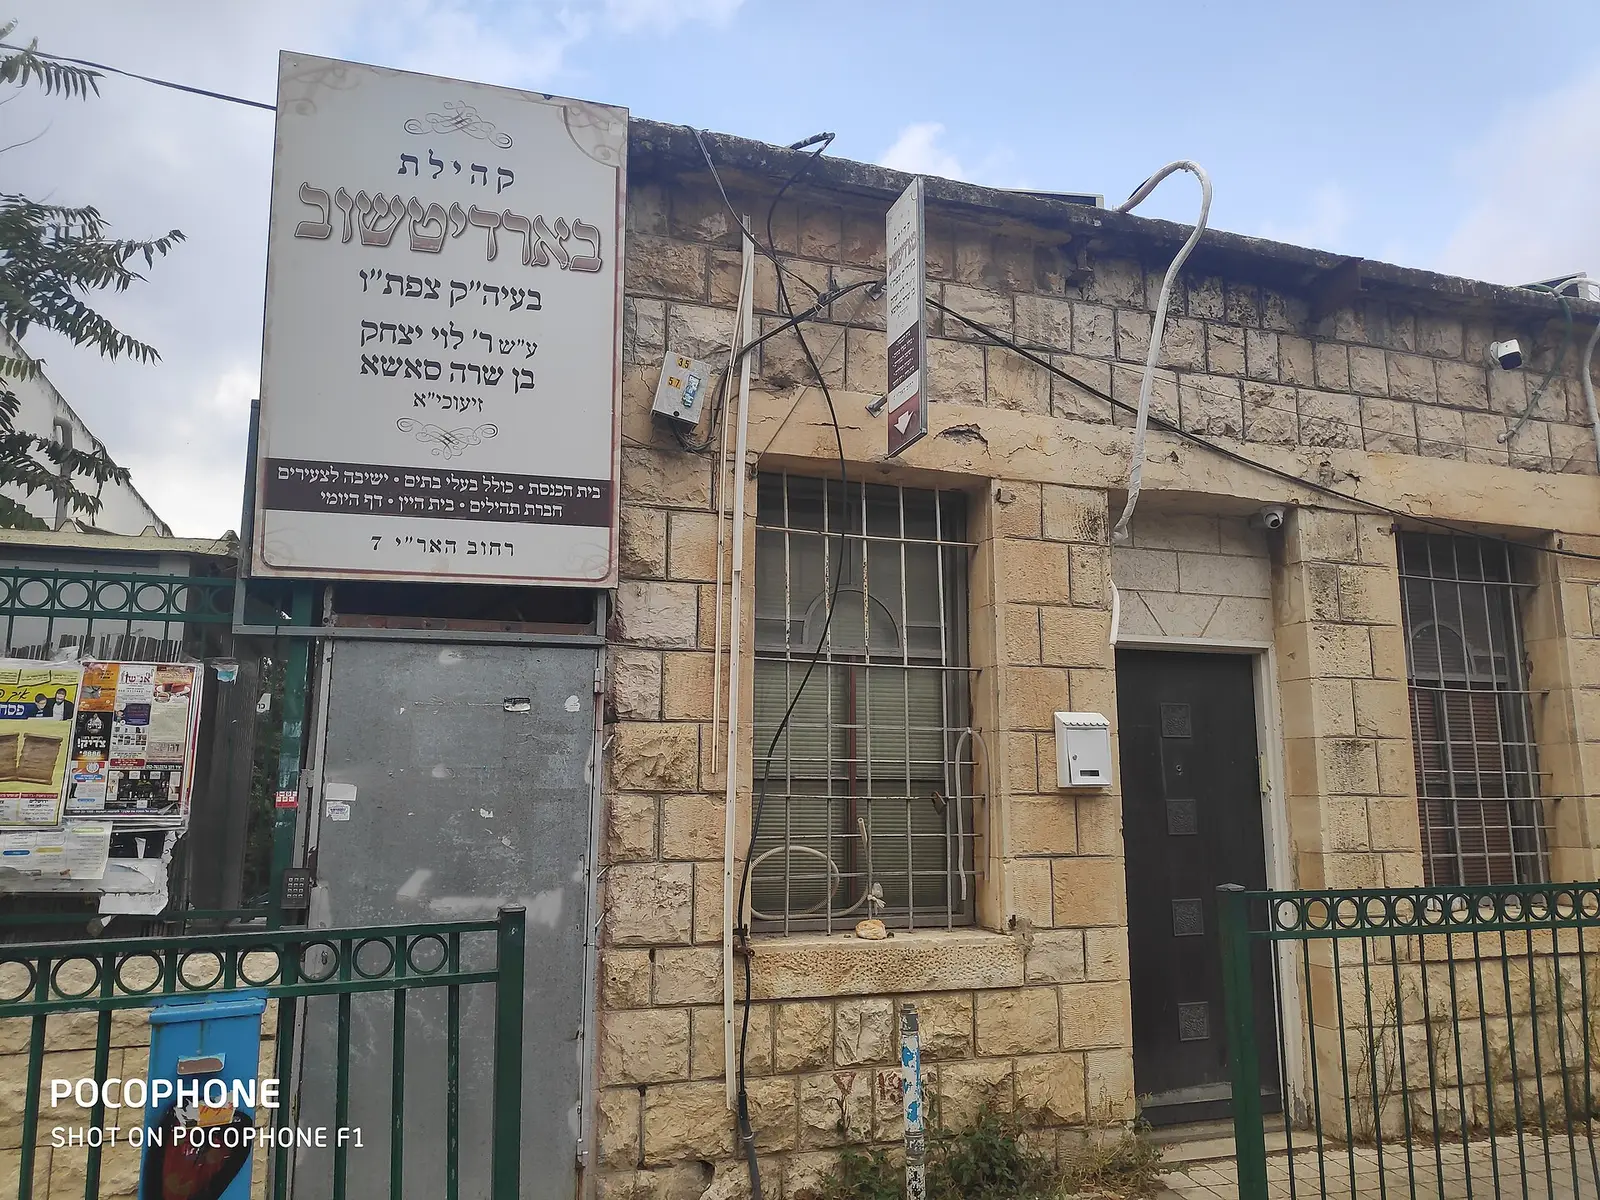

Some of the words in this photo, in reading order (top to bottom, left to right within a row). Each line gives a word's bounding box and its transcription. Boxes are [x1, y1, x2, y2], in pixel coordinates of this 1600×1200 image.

[397, 149, 515, 194] קהילת
[294, 181, 603, 274] בארדיטשוב
[450, 280, 542, 311] בעיה"ק
[361, 319, 423, 347] יצחק
[432, 321, 464, 350] לוי
[360, 354, 441, 380] סאשא
[677, 358, 690, 369] 35
[450, 361, 504, 385] שרה
[512, 367, 535, 394] בן
[278, 465, 339, 483] לצעירים
[344, 471, 388, 485] ישיבה
[405, 475, 441, 488] בתים
[446, 471, 480, 492] בעלי
[483, 475, 513, 493] כולל
[528, 483, 572, 497] הכנסת
[577, 486, 602, 499] בית
[321, 491, 359, 505] היומי
[364, 494, 383, 510] דף
[428, 498, 454, 512] בית
[470, 497, 520, 514] תהילים
[524, 504, 563, 517] חברת
[371, 536, 382, 550] 7
[396, 536, 456, 554] האר"י
[467, 541, 513, 556] רחוב
[77, 738, 107, 749] צדיק!
